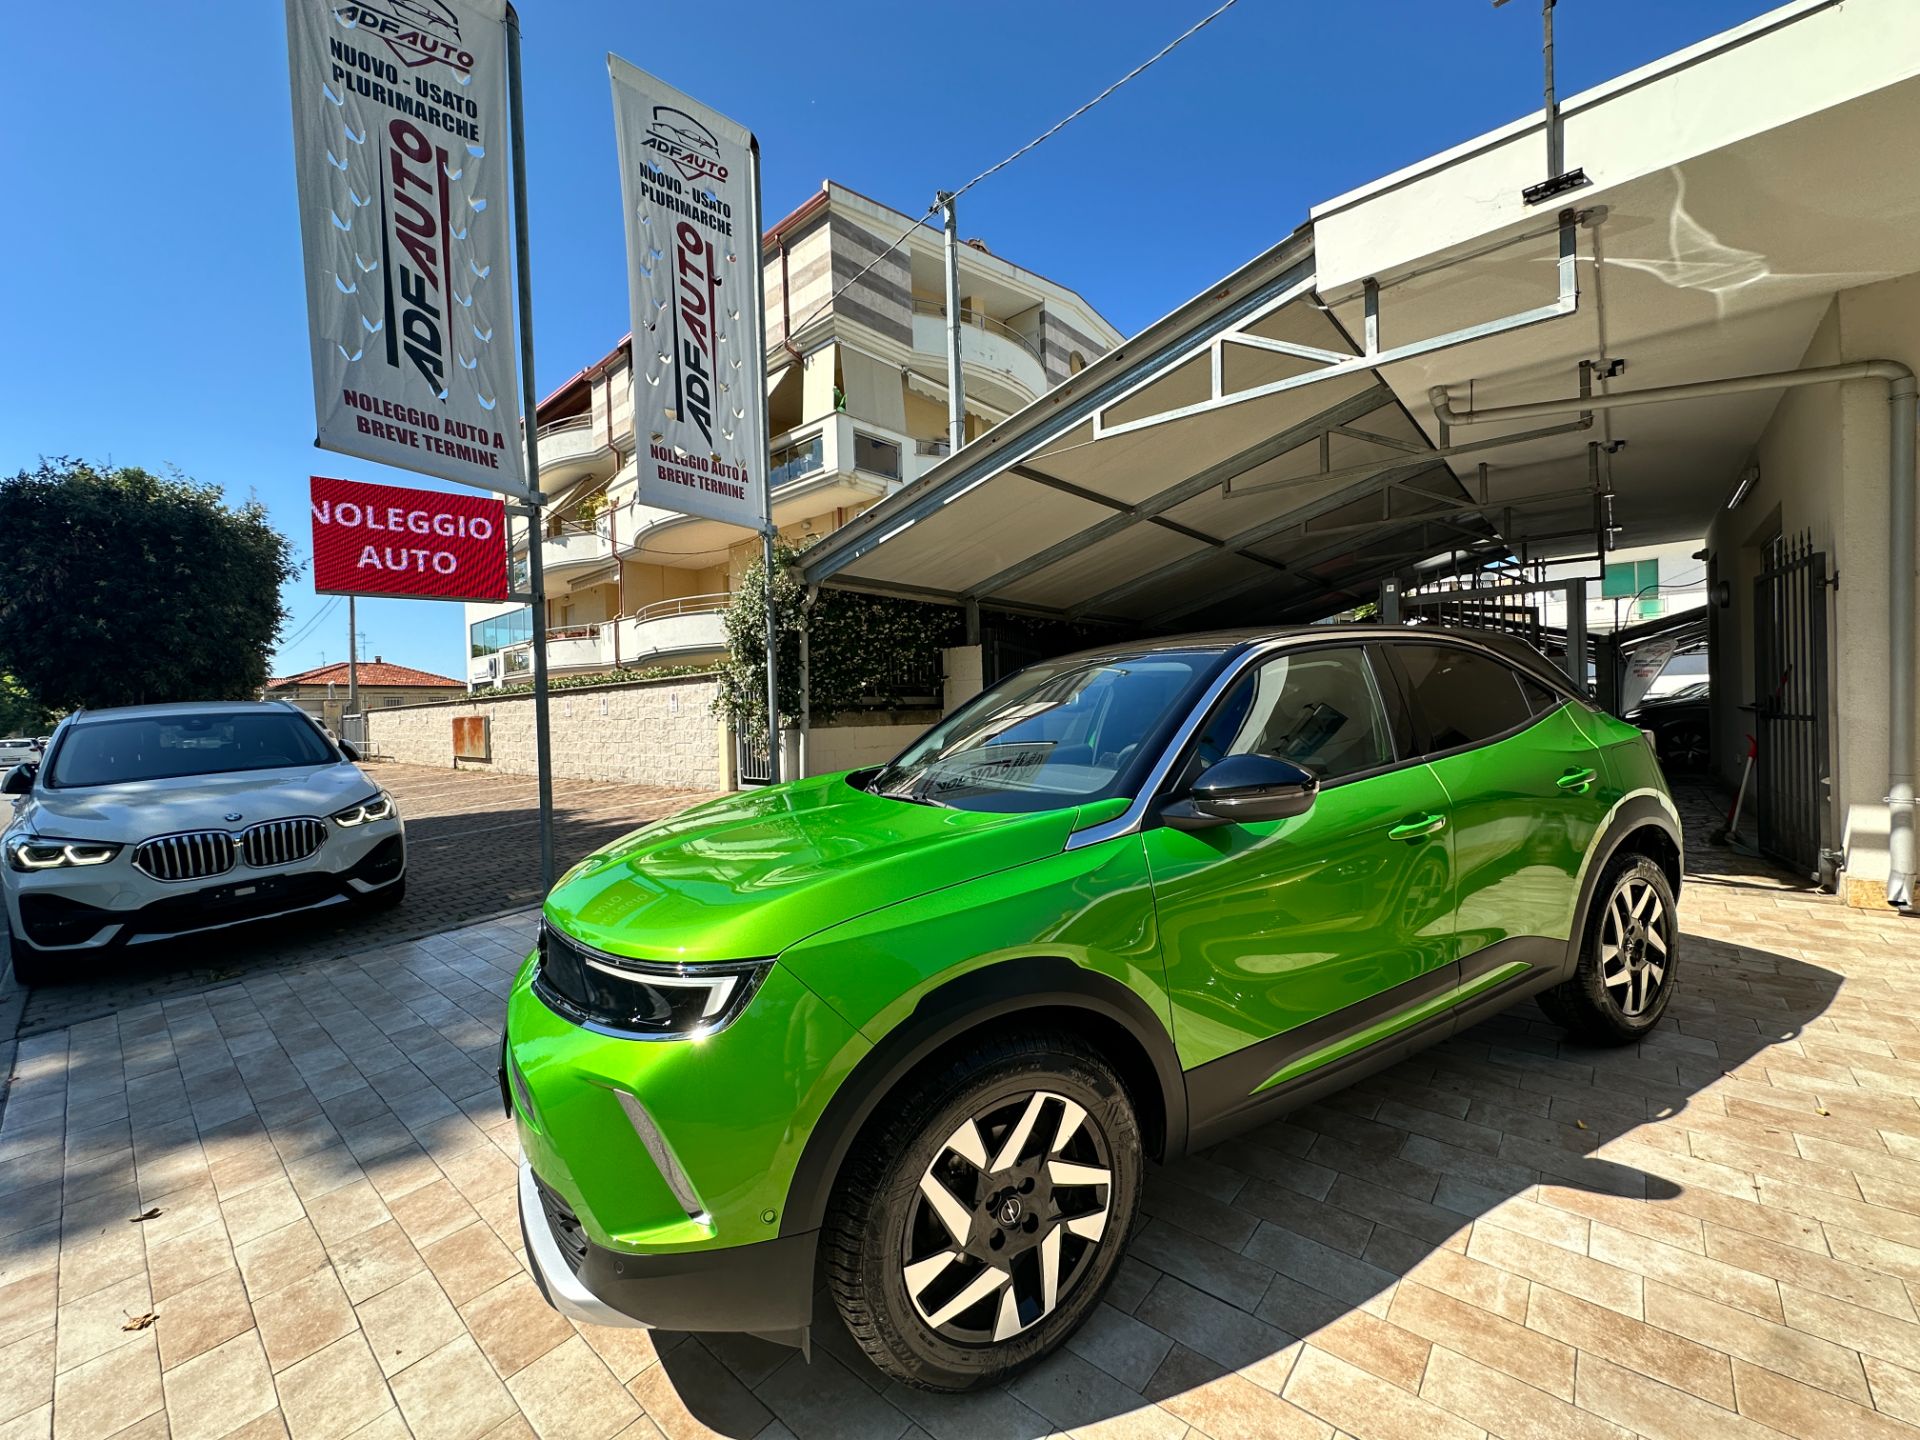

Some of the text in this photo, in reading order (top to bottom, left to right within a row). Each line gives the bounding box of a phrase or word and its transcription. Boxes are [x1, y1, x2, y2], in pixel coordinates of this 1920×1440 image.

[329, 37, 398, 86] NUOVO
[415, 77, 478, 119] USATO
[332, 62, 479, 142] PLURIMARCHE
[639, 162, 682, 195] NUOVO
[641, 181, 732, 237] PLURIMARCHE
[343, 389, 505, 450] NOLEGGIO AUTO A
[356, 415, 499, 469] BREVE TERMINE
[650, 444, 749, 483] NOLEGGIO AUTO A
[657, 465, 745, 500] BREVE TERMINE
[311, 500, 493, 540] NOLEGGIO
[357, 545, 458, 575] AUTO
